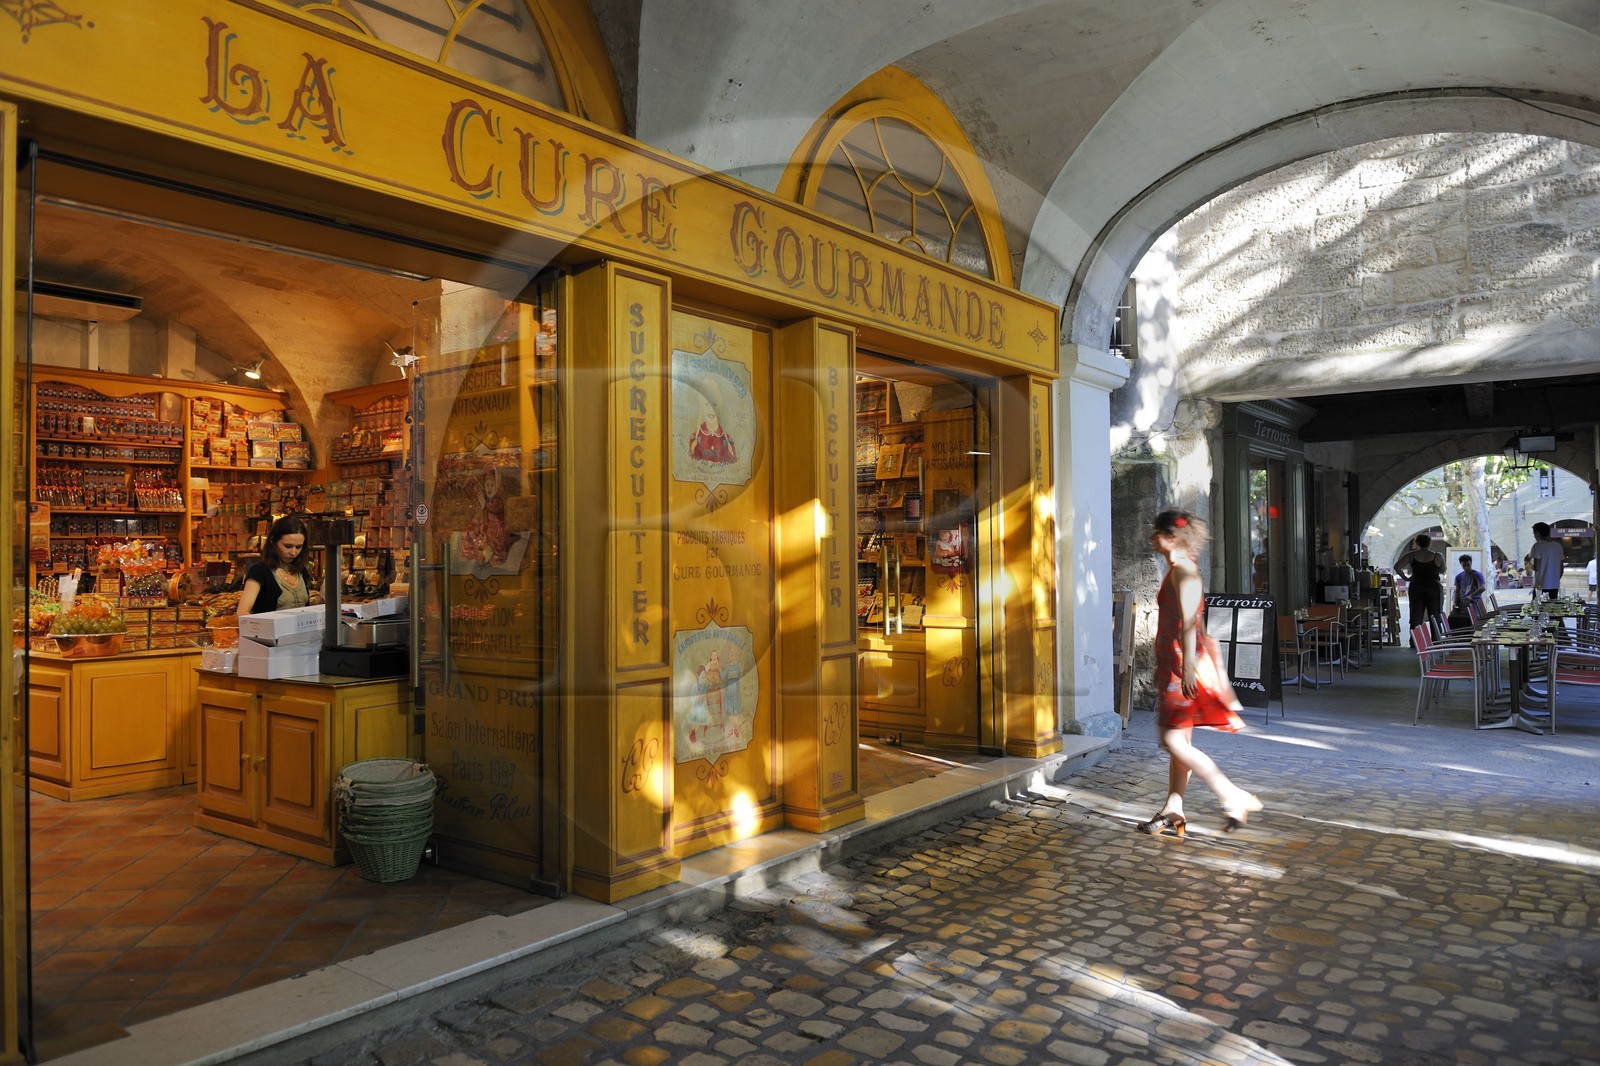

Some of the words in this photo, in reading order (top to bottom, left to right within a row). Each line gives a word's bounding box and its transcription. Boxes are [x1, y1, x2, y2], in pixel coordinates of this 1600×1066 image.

[200, 16, 356, 156] LA
[442, 98, 678, 252] CURE
[729, 200, 1006, 349] GOURMANDE
[451, 392, 512, 417] ARTISANAUX
[1254, 420, 1291, 444] Terroirs
[932, 439, 968, 454] NOUGATS
[629, 303, 650, 646] SUCRECUITIER
[827, 366, 842, 609] BISCUITIER
[676, 530, 709, 545] PRODUITS
[711, 529, 746, 546] FABRIQUÉS
[706, 547, 719, 561] par
[674, 565, 701, 581] CURE
[705, 563, 762, 580] GOURMANDE
[1205, 595, 1274, 609] Terroirs
[429, 680, 490, 702] GRAND
[496, 687, 539, 710] PRIX
[431, 711, 461, 741] Salon
[464, 717, 538, 756] Internationa
[451, 750, 484, 785] Paris
[490, 760, 517, 791] 1997
[490, 793, 531, 821] Bleu
